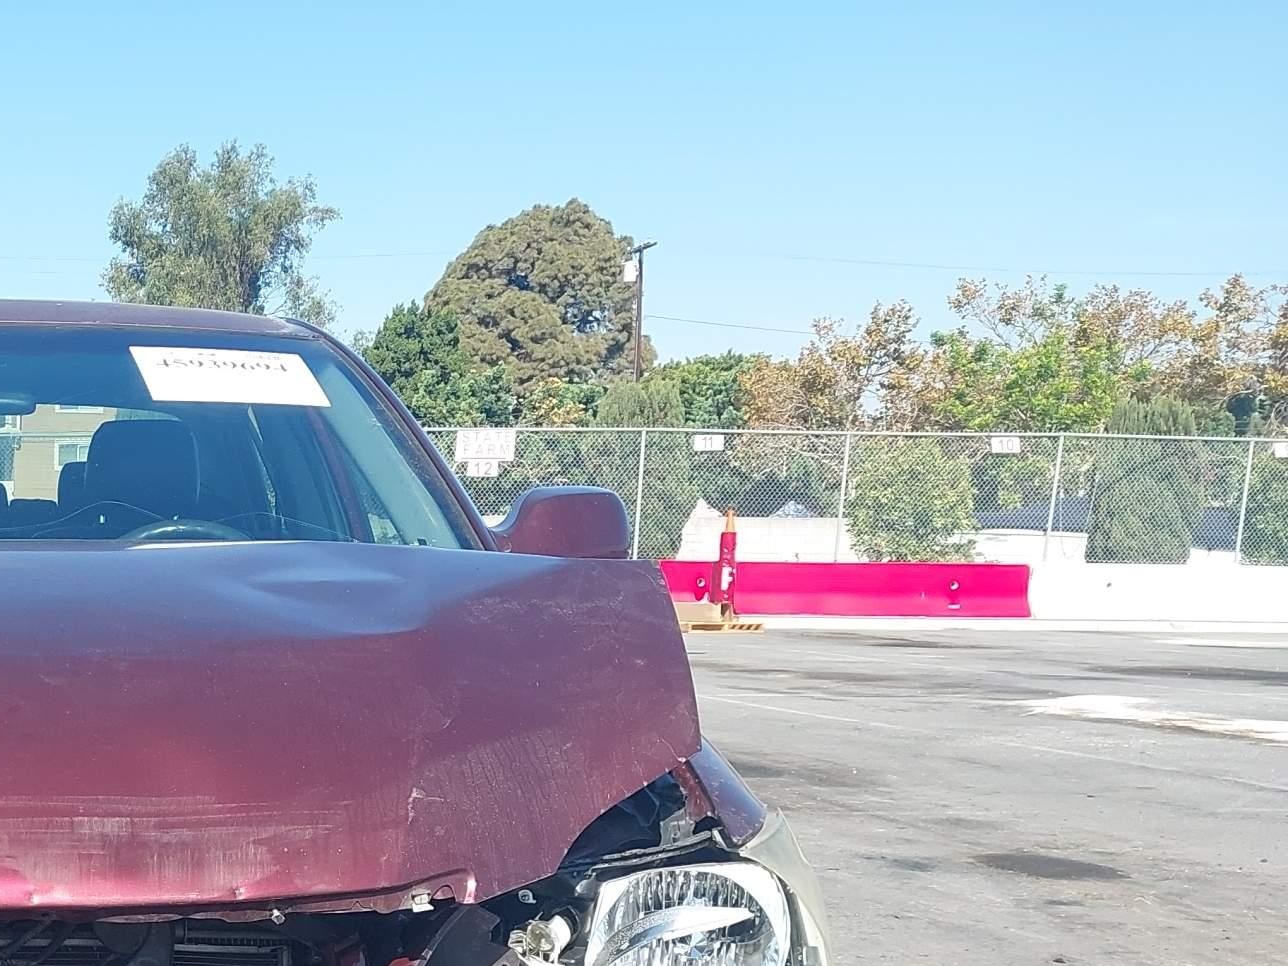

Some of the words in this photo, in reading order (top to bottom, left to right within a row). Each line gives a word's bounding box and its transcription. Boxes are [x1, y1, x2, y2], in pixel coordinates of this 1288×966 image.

[462, 430, 511, 443] STATE
[702, 436, 713, 449] 11
[463, 443, 510, 456] FARM
[998, 438, 1014, 451] 10
[474, 462, 492, 475] 12
